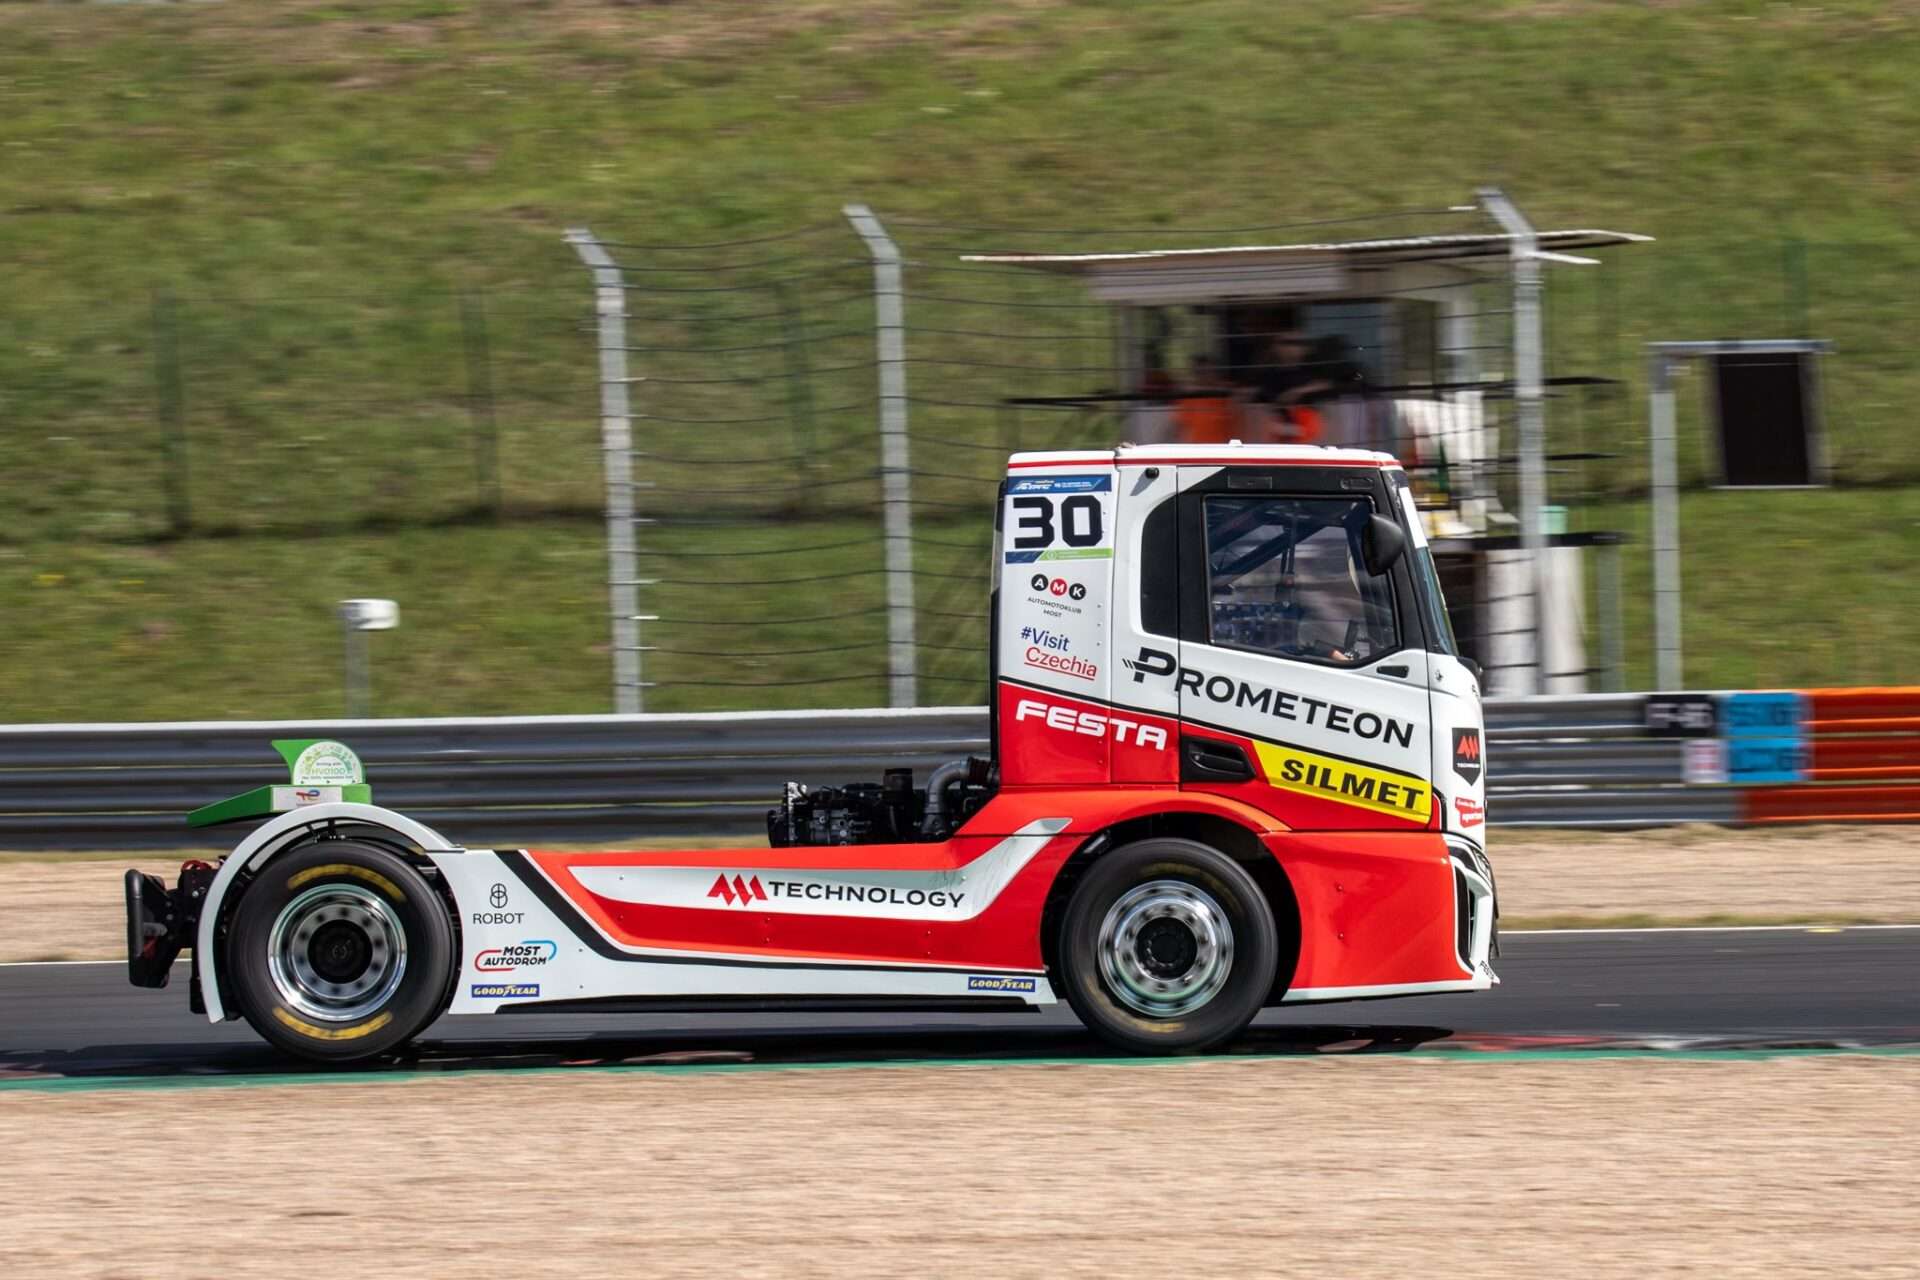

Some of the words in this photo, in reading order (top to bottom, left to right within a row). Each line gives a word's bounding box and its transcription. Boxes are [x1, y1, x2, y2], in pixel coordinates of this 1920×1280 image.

[1013, 495, 1103, 549] 30
[1033, 576, 1085, 599] AMK
[1020, 626, 1070, 652] #Visit
[1025, 647, 1097, 677] Czechia
[1127, 647, 1414, 749] PROMETEON
[1016, 699, 1168, 751] FESTA
[1280, 759, 1424, 810] SILMET
[768, 881, 965, 908] TECHNOLOGY
[472, 913, 525, 924] ROBOT
[484, 957, 547, 966] AUTODROM
[503, 946, 541, 956] MOST
